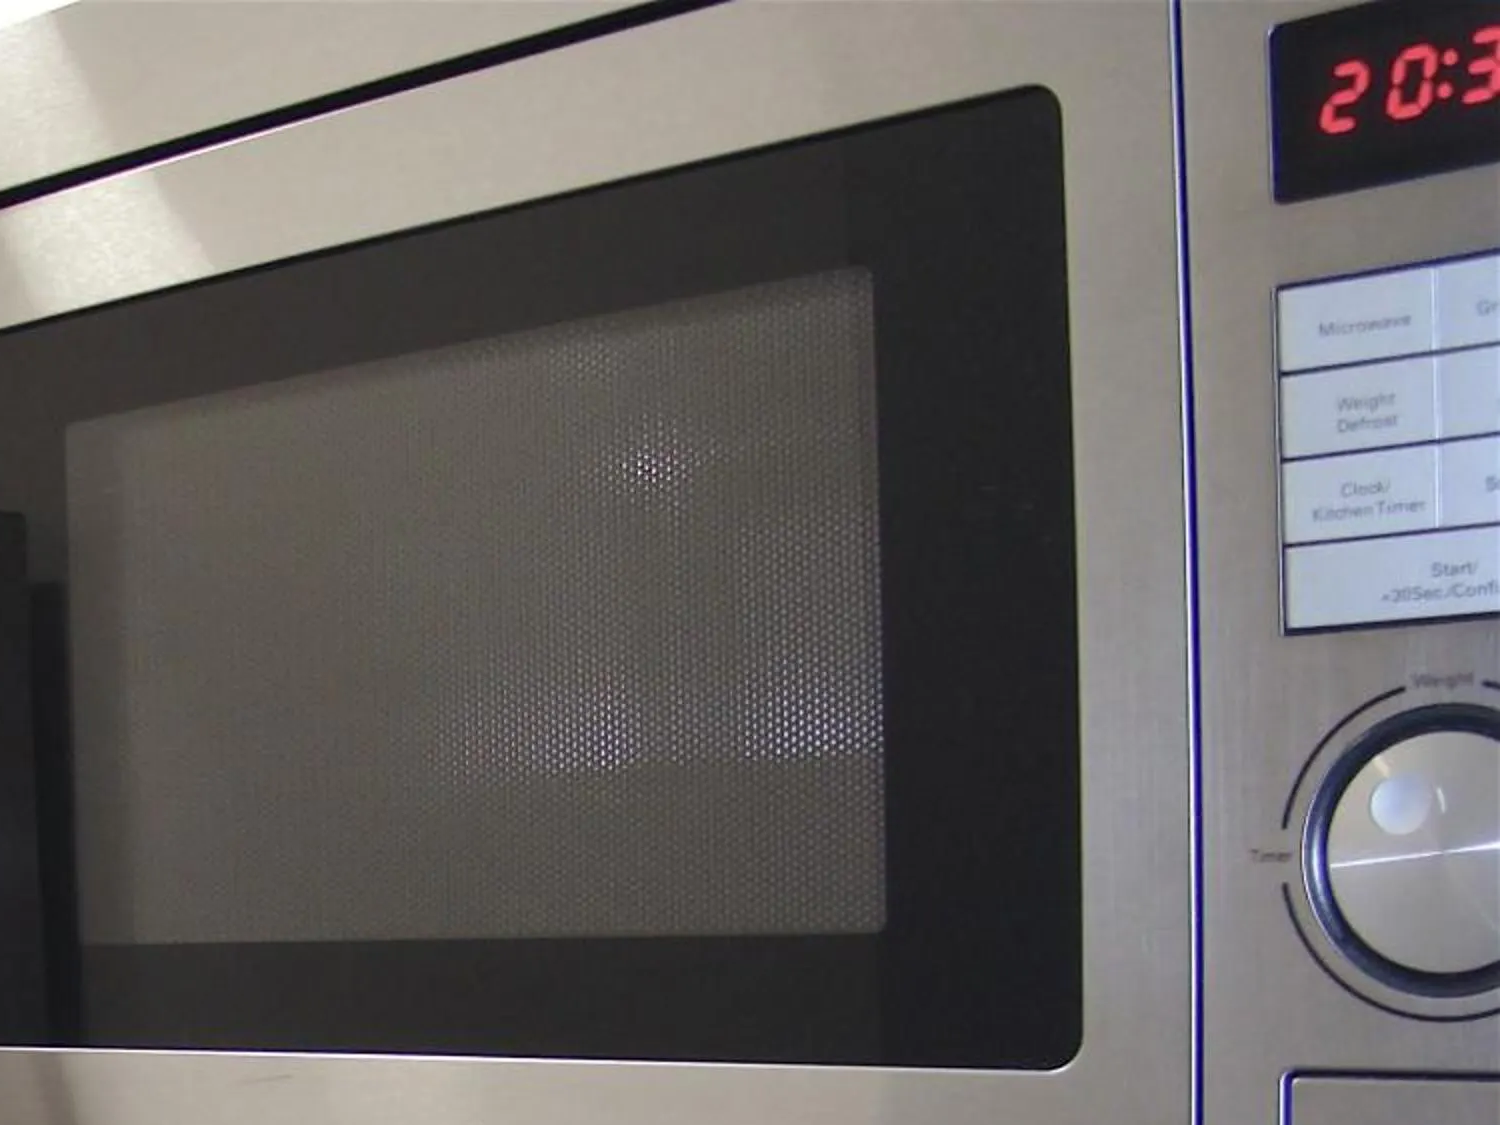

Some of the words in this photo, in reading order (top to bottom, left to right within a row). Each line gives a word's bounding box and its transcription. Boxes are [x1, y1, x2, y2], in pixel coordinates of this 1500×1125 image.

[1318, 314, 1412, 337] Microwave
[1337, 392, 1396, 414] Weight
[1337, 415, 1398, 433] Defrost
[1312, 505, 1375, 521] Kitchen
[1376, 499, 1426, 514] Timer
[1409, 671, 1474, 692] Weight
[1249, 848, 1293, 864] Timer
